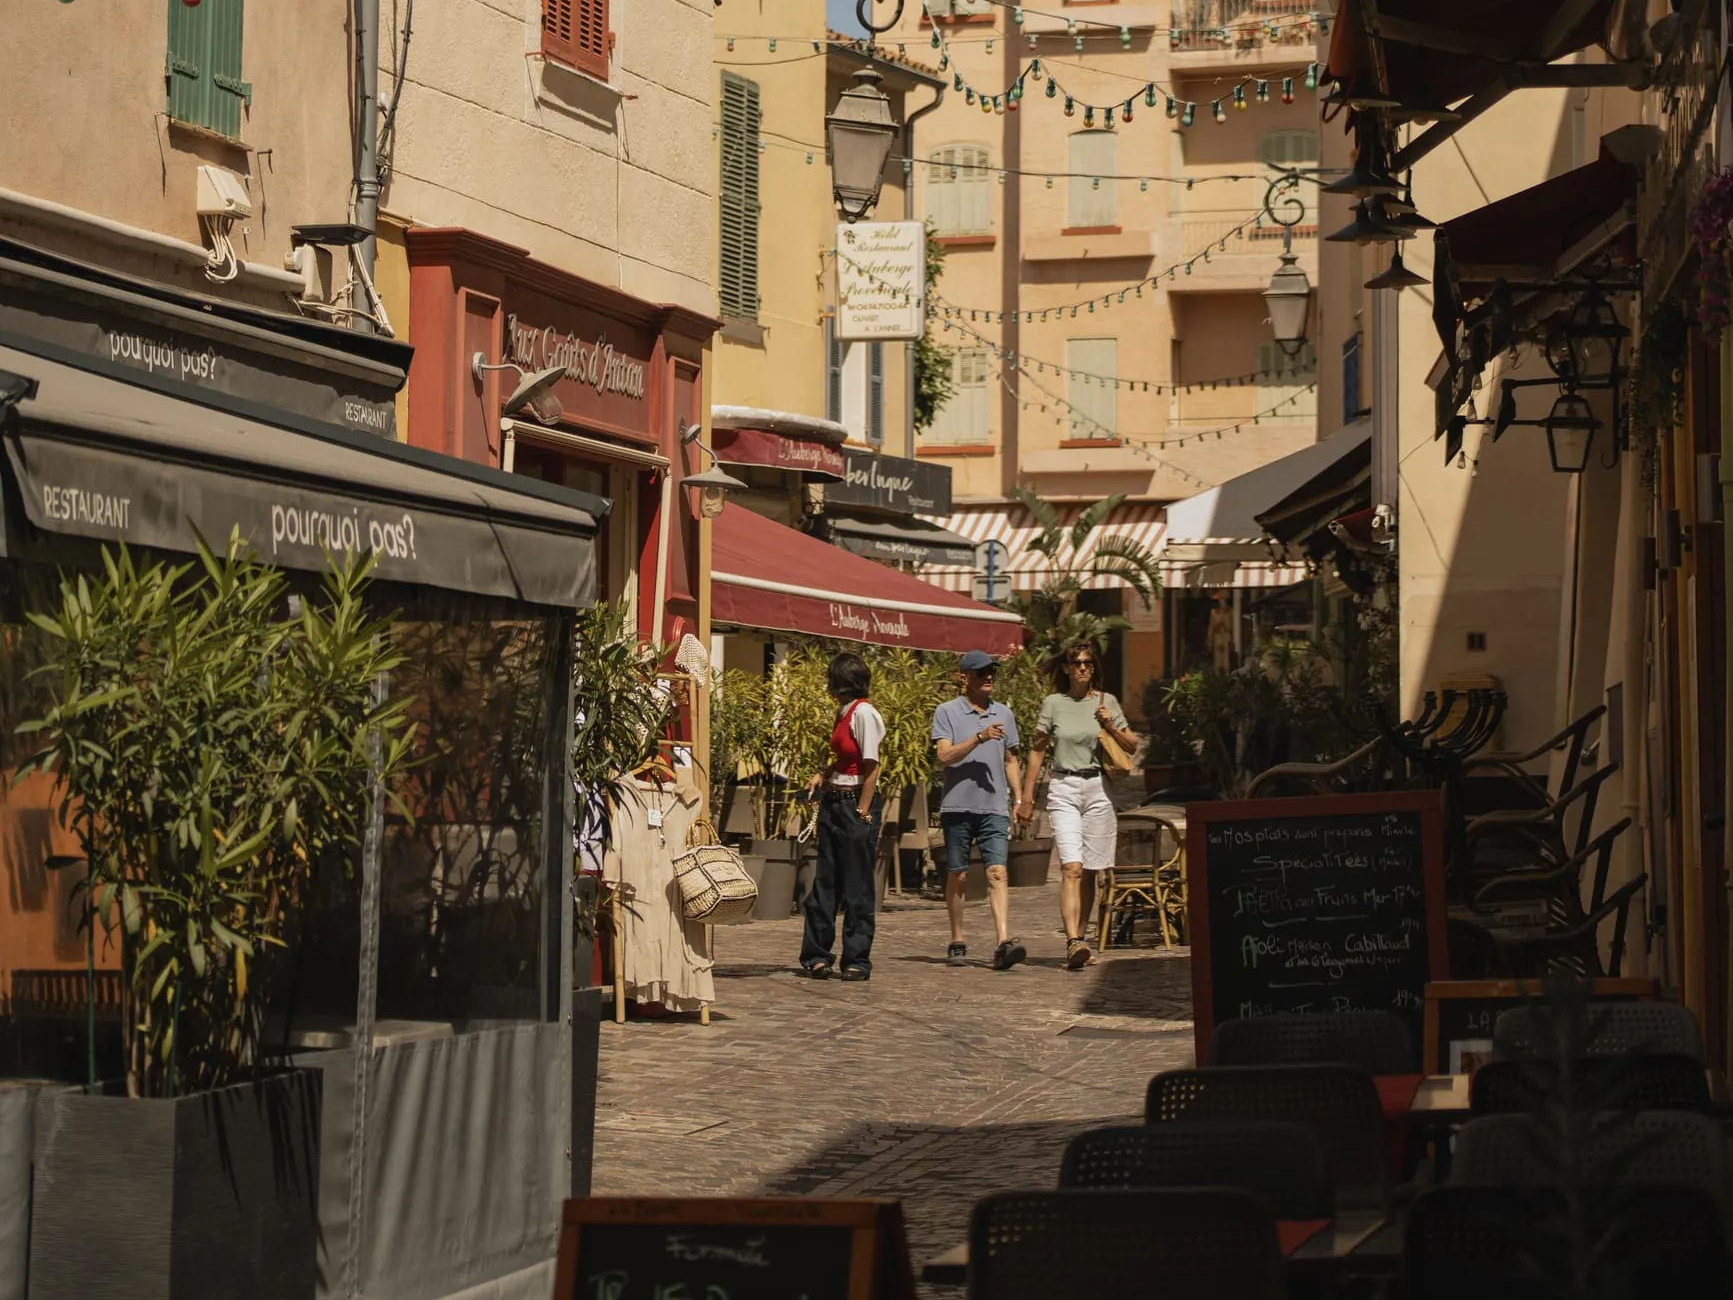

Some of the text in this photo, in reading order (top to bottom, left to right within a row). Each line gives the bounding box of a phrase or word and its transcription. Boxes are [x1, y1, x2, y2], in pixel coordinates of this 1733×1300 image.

[110, 333, 217, 380] pourquoi pas?
[502, 313, 645, 399] Aux Goûts d'Antan
[344, 401, 388, 430] RESTAURANT
[43, 485, 131, 530] RESTAURANT
[271, 503, 417, 566] pourquoi pas?
